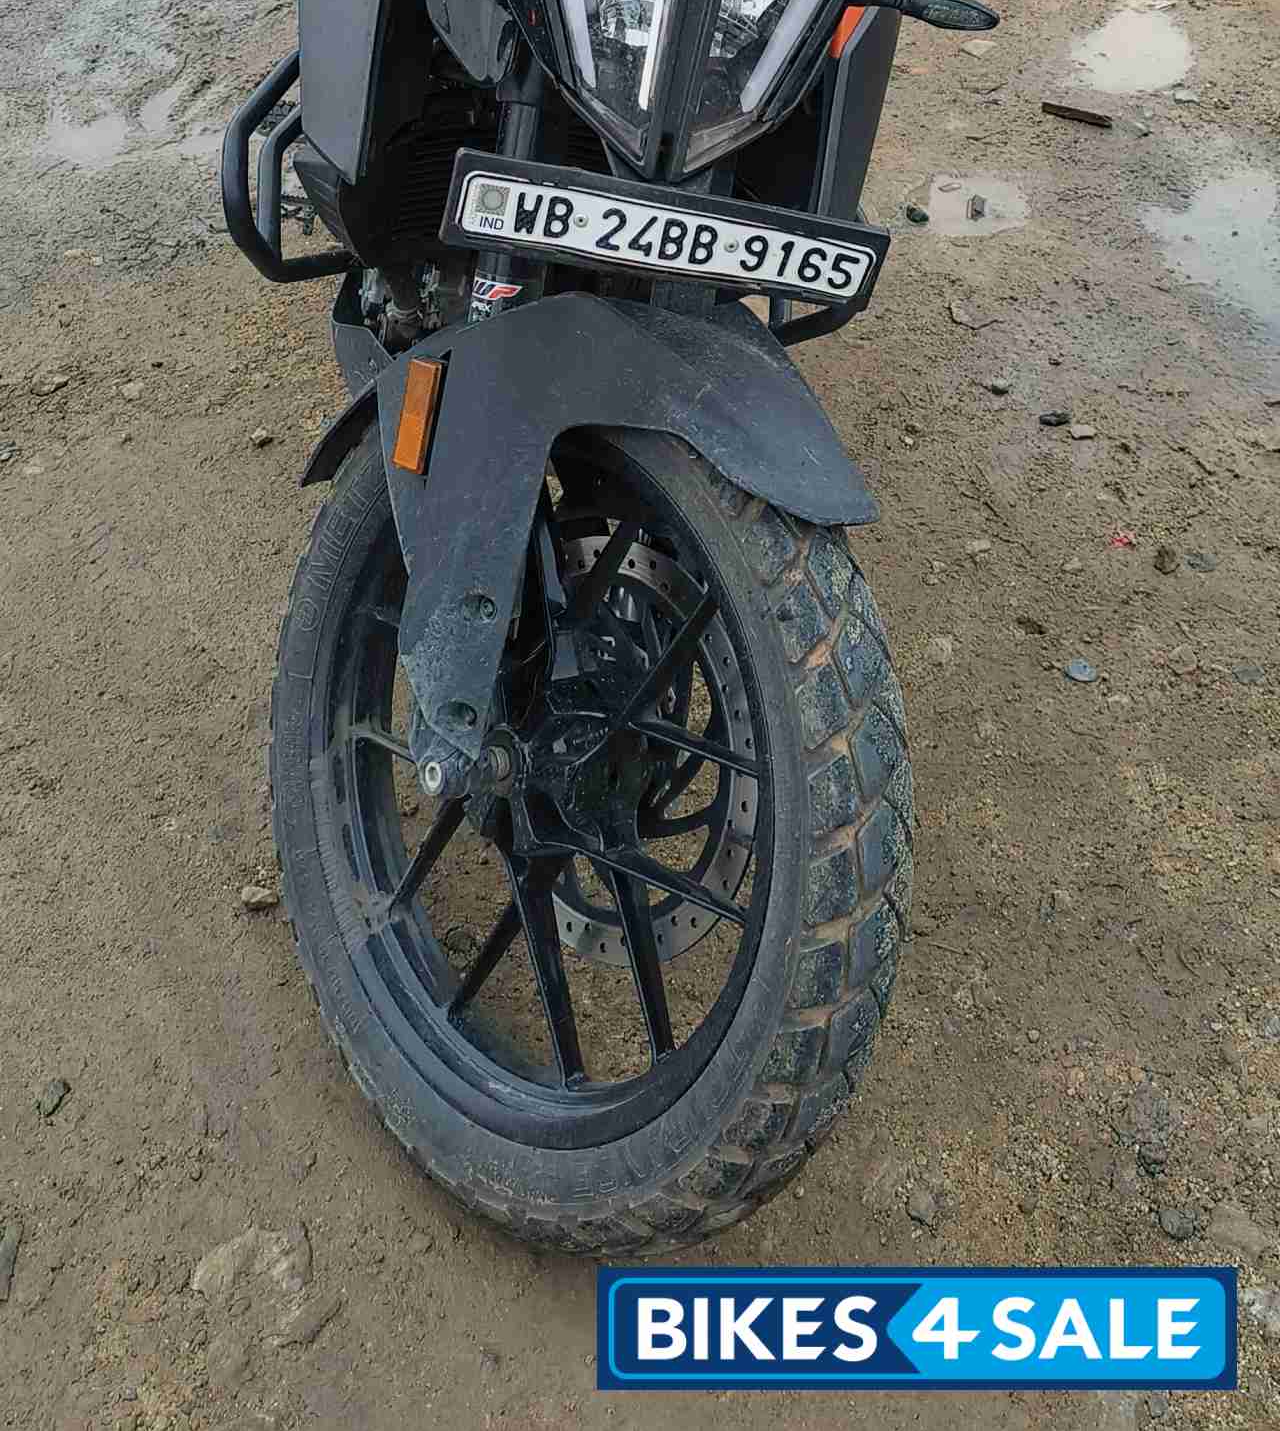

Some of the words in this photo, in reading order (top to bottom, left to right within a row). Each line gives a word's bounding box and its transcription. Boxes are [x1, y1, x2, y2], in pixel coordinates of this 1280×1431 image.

[480, 216, 504, 231] IND
[514, 192, 574, 238] WB
[596, 208, 718, 265] 24BB
[740, 235, 861, 290] 9165
